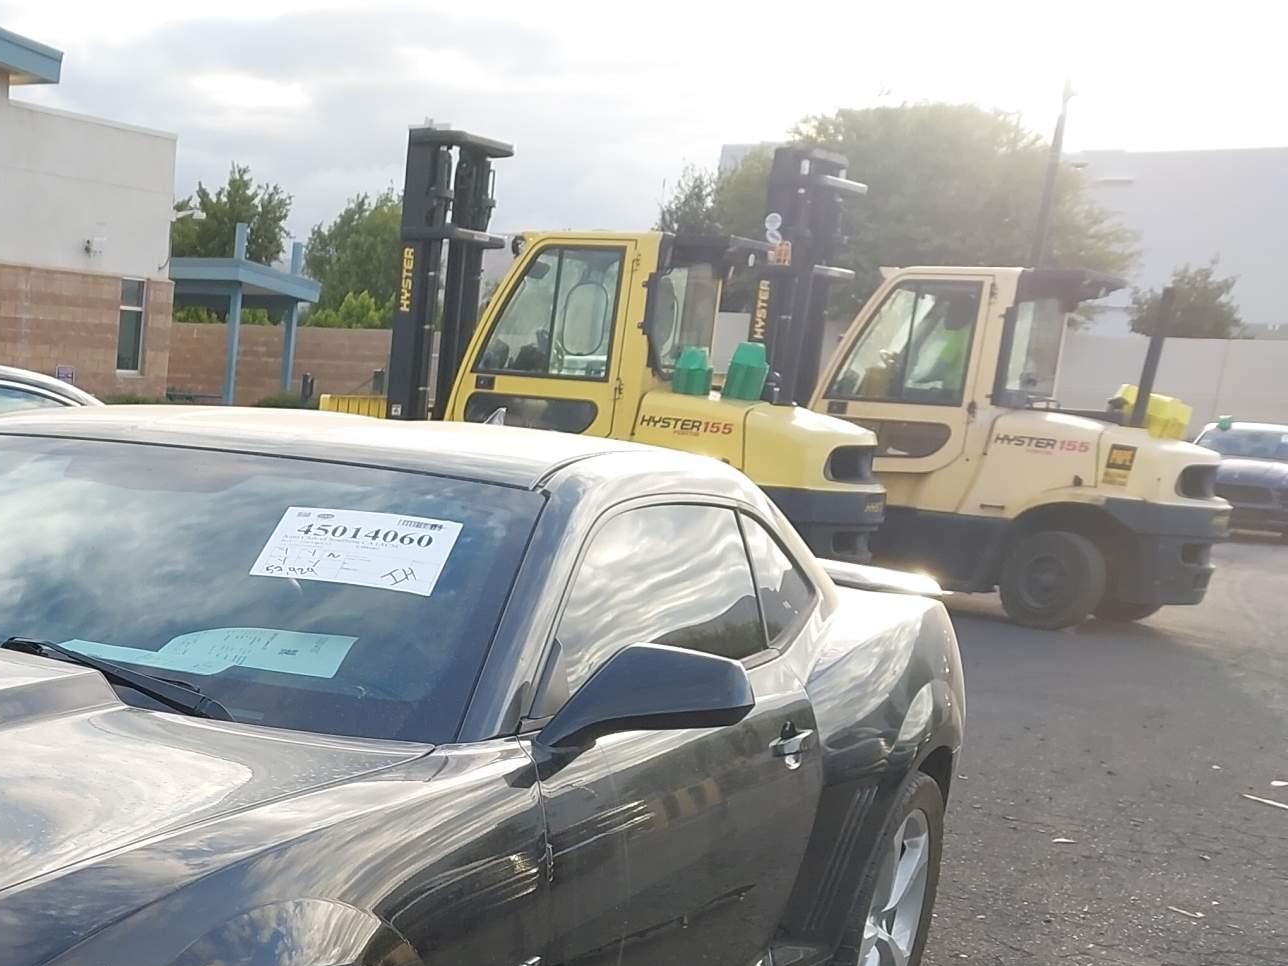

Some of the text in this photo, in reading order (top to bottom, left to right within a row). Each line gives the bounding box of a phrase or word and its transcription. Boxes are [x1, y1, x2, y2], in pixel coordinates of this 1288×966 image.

[399, 247, 415, 313] HYSTER
[753, 280, 771, 339] HYSTER
[640, 414, 702, 432] HYSTER
[703, 421, 735, 435] 155
[994, 433, 1057, 449] HYSTER
[1058, 439, 1091, 453] 155
[297, 523, 433, 548] 45014060
